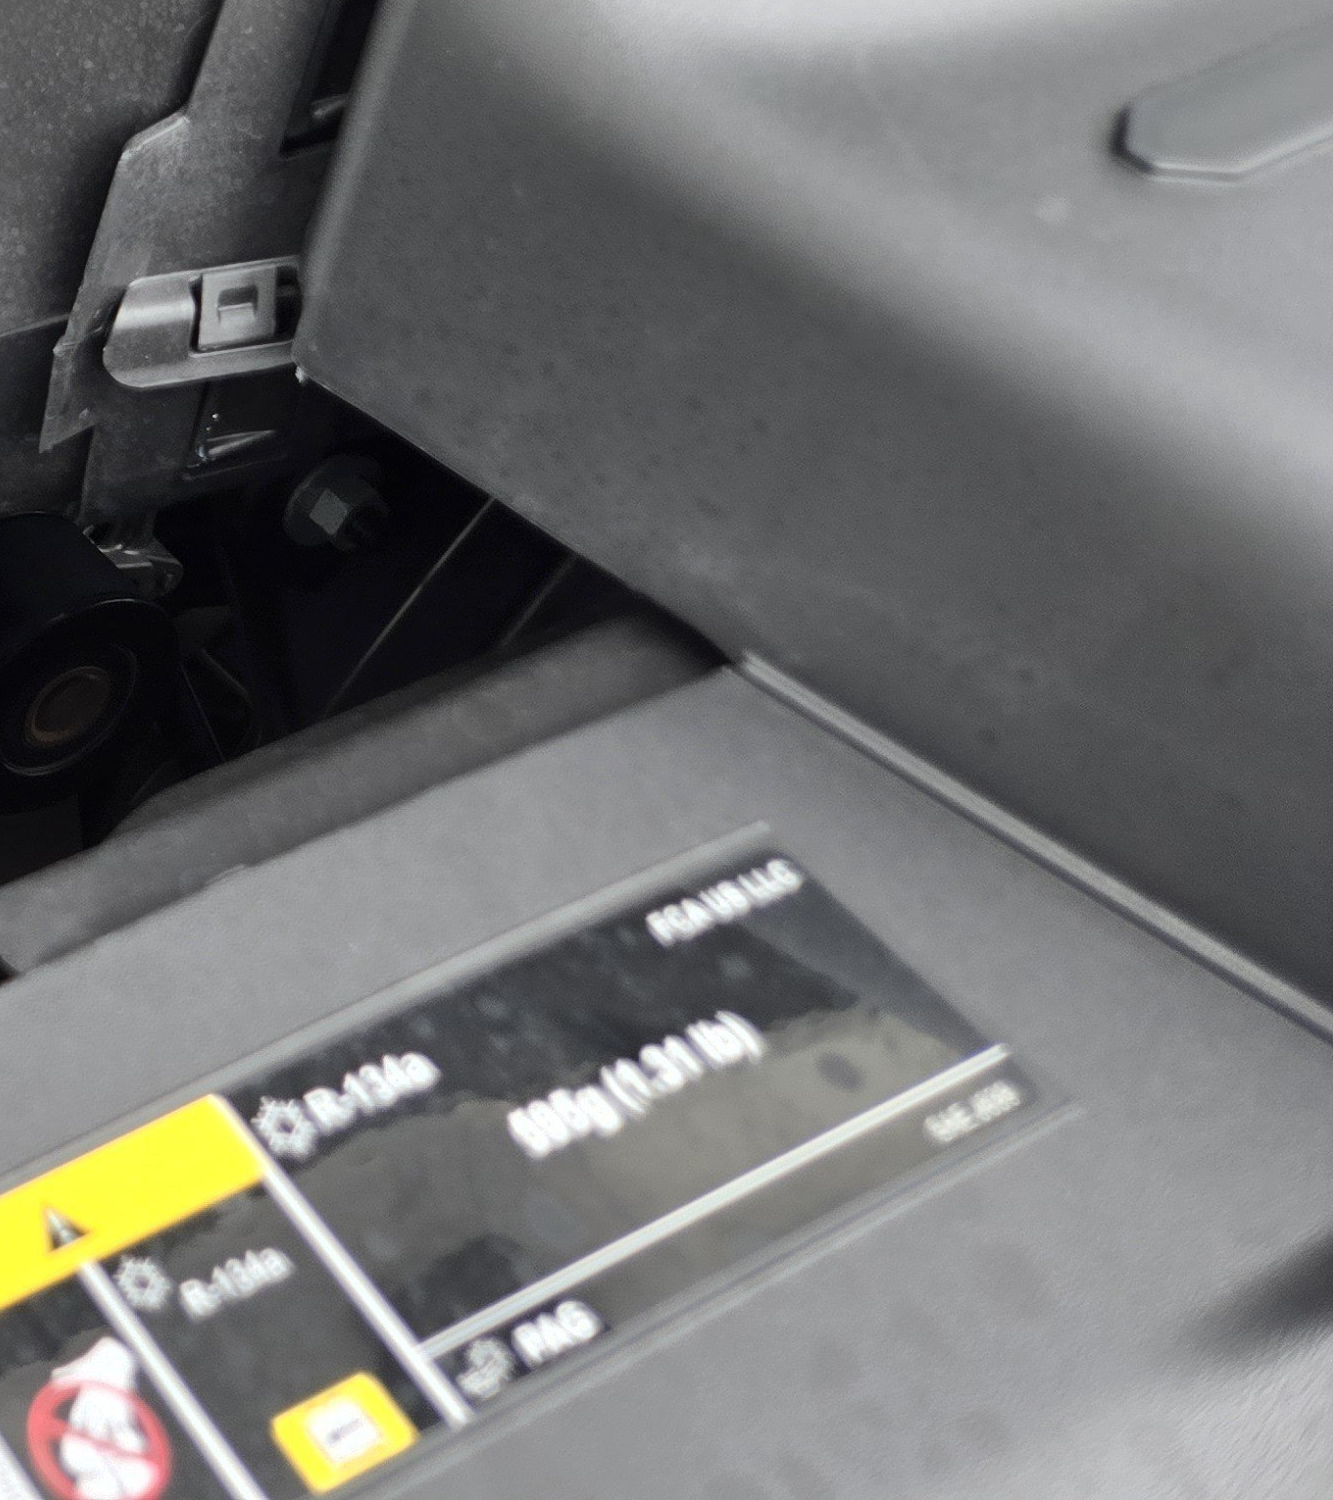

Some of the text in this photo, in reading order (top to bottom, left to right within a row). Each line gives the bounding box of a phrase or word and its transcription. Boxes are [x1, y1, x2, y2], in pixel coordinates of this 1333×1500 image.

[645, 857, 804, 947] FCA US LLC
[303, 1051, 442, 1136] R-134a
[600, 1034, 704, 1120] (1.31
[684, 1009, 765, 1070] lb)
[179, 1248, 294, 1323] R-134a
[511, 1299, 602, 1368] PAG
